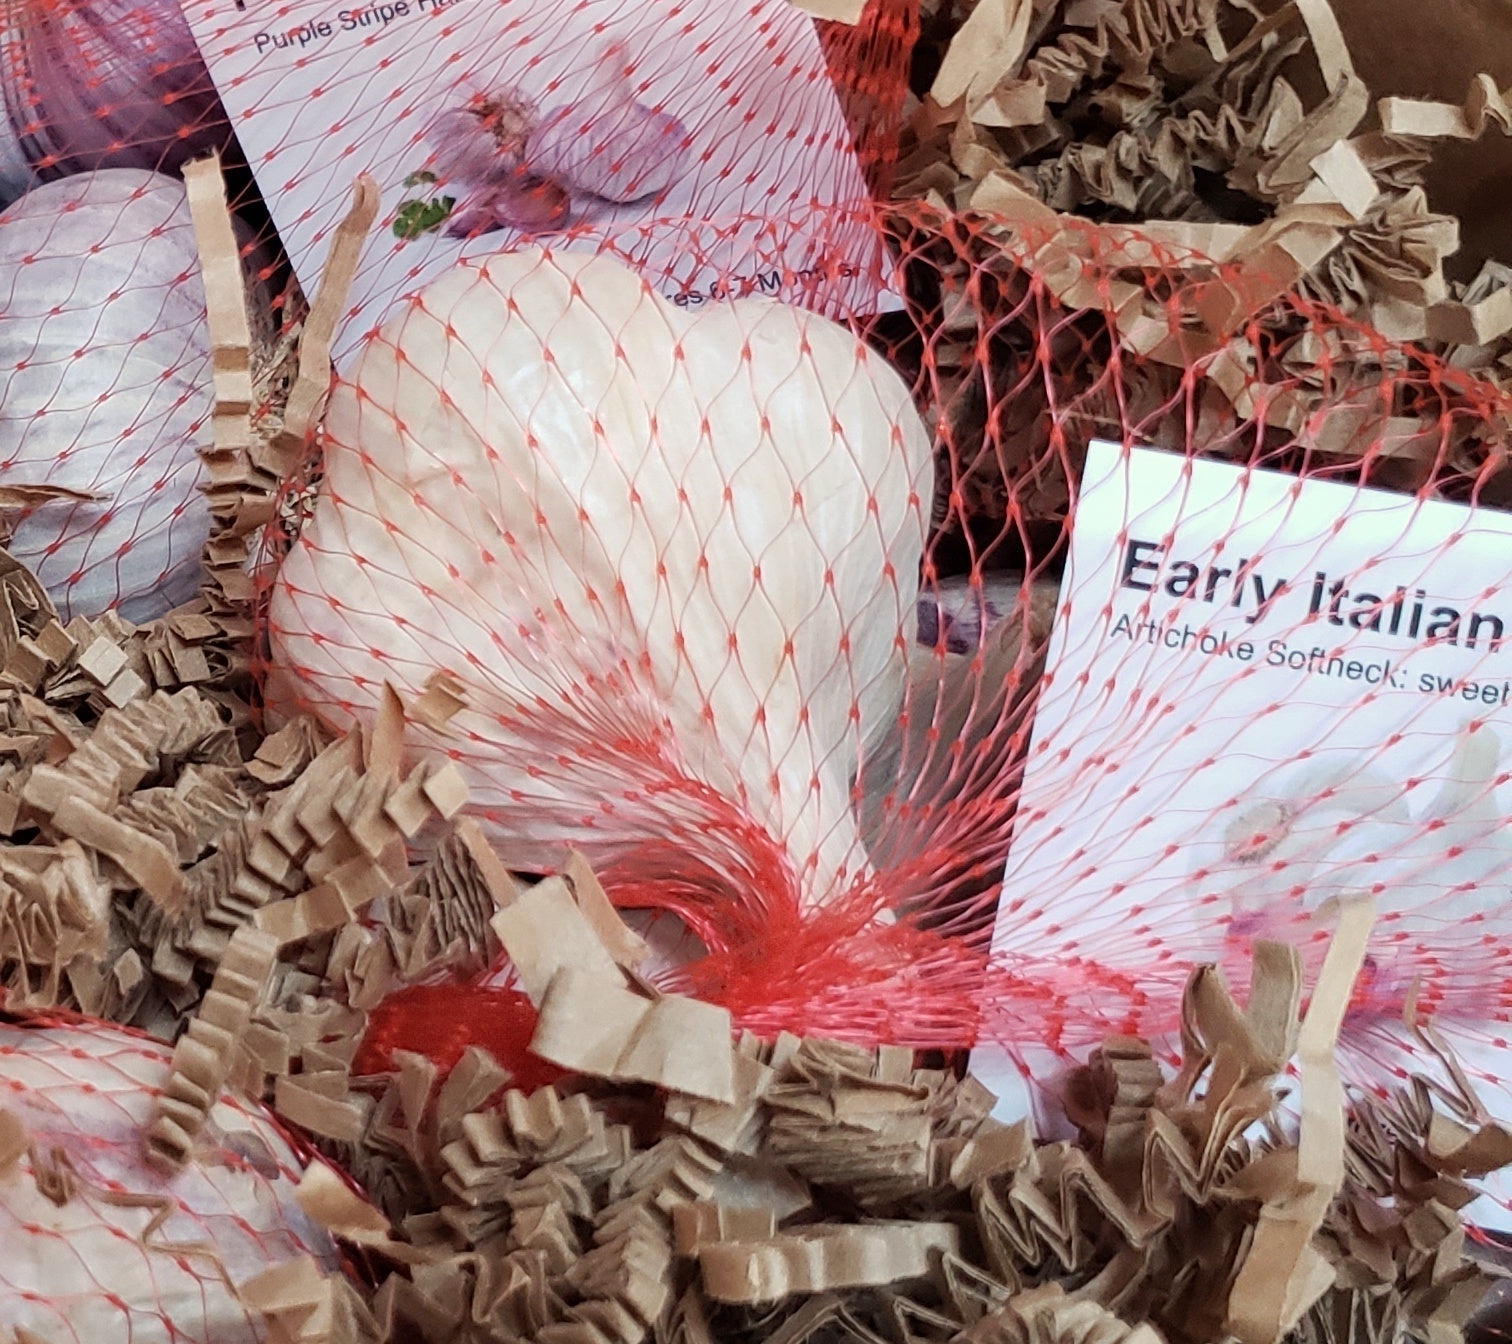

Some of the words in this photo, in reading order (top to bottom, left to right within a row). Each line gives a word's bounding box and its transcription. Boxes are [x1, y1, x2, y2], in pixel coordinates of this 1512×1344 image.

[254, 21, 333, 54] Purple
[338, 0, 410, 31] Stripe
[1121, 539, 1287, 623] Early
[1309, 571, 1504, 652] Italian
[1110, 613, 1254, 661] Artichoke
[1266, 639, 1408, 689] Softneck:
